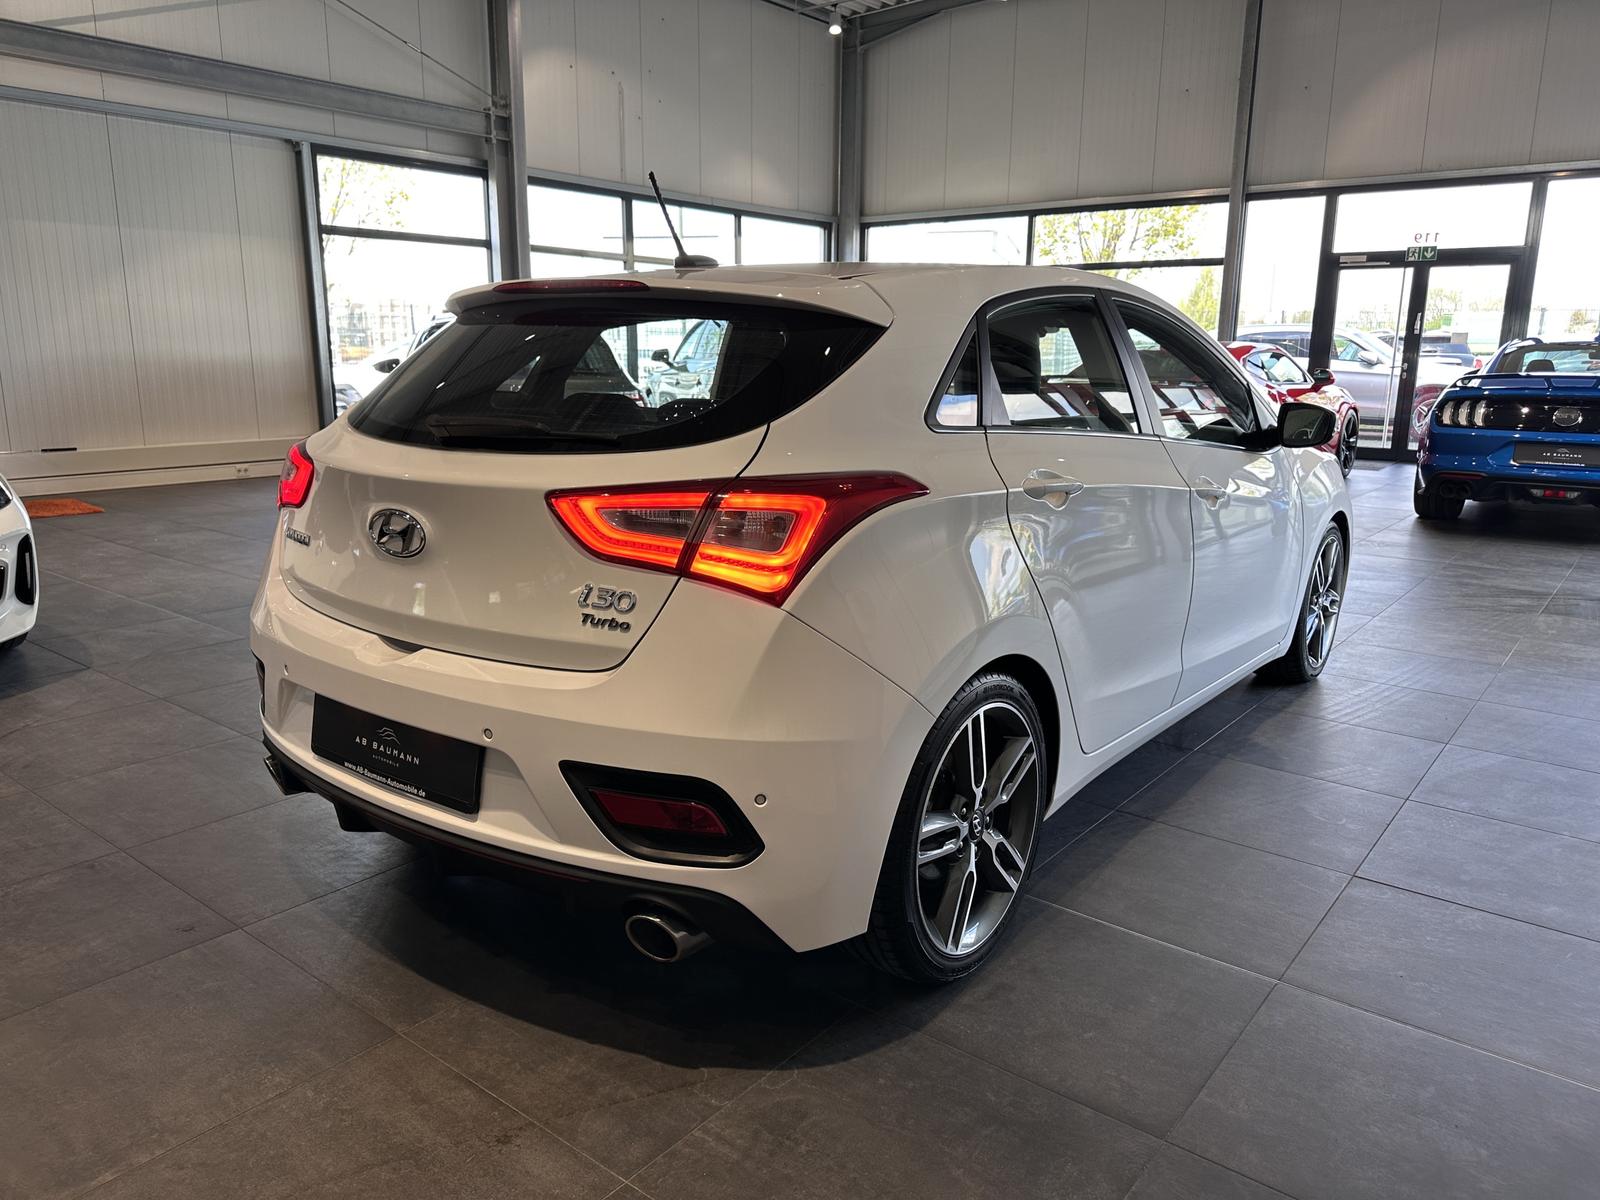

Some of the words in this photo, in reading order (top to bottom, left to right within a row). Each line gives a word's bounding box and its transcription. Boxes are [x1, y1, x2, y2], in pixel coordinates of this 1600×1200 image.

[578, 583, 637, 614] i30
[581, 612, 631, 632] Turbo
[355, 735, 367, 746] AB
[372, 741, 420, 765] BAUMANN
[344, 761, 426, 798] www.AB-Baumann-Automobile.de
